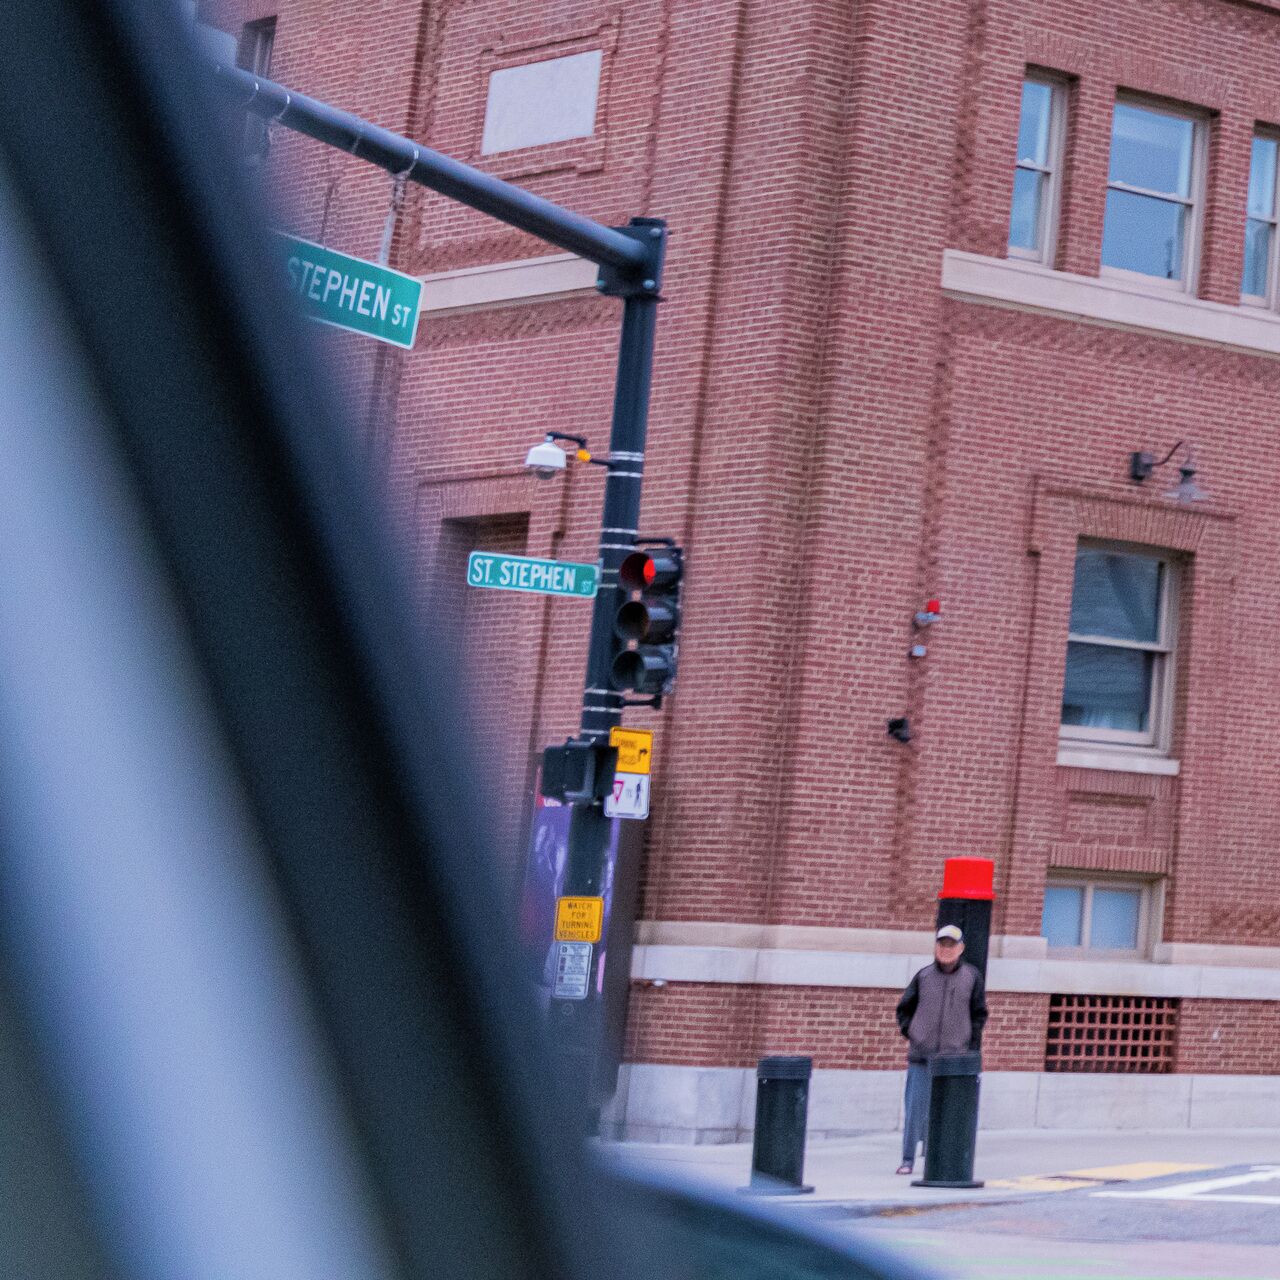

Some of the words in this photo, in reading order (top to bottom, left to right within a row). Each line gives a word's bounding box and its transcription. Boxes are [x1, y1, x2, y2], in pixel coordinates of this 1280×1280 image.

[391, 304, 412, 328] ST
[472, 558, 494, 584] ST.
[500, 561, 577, 592] STEPHEN
[581, 580, 593, 593] ST
